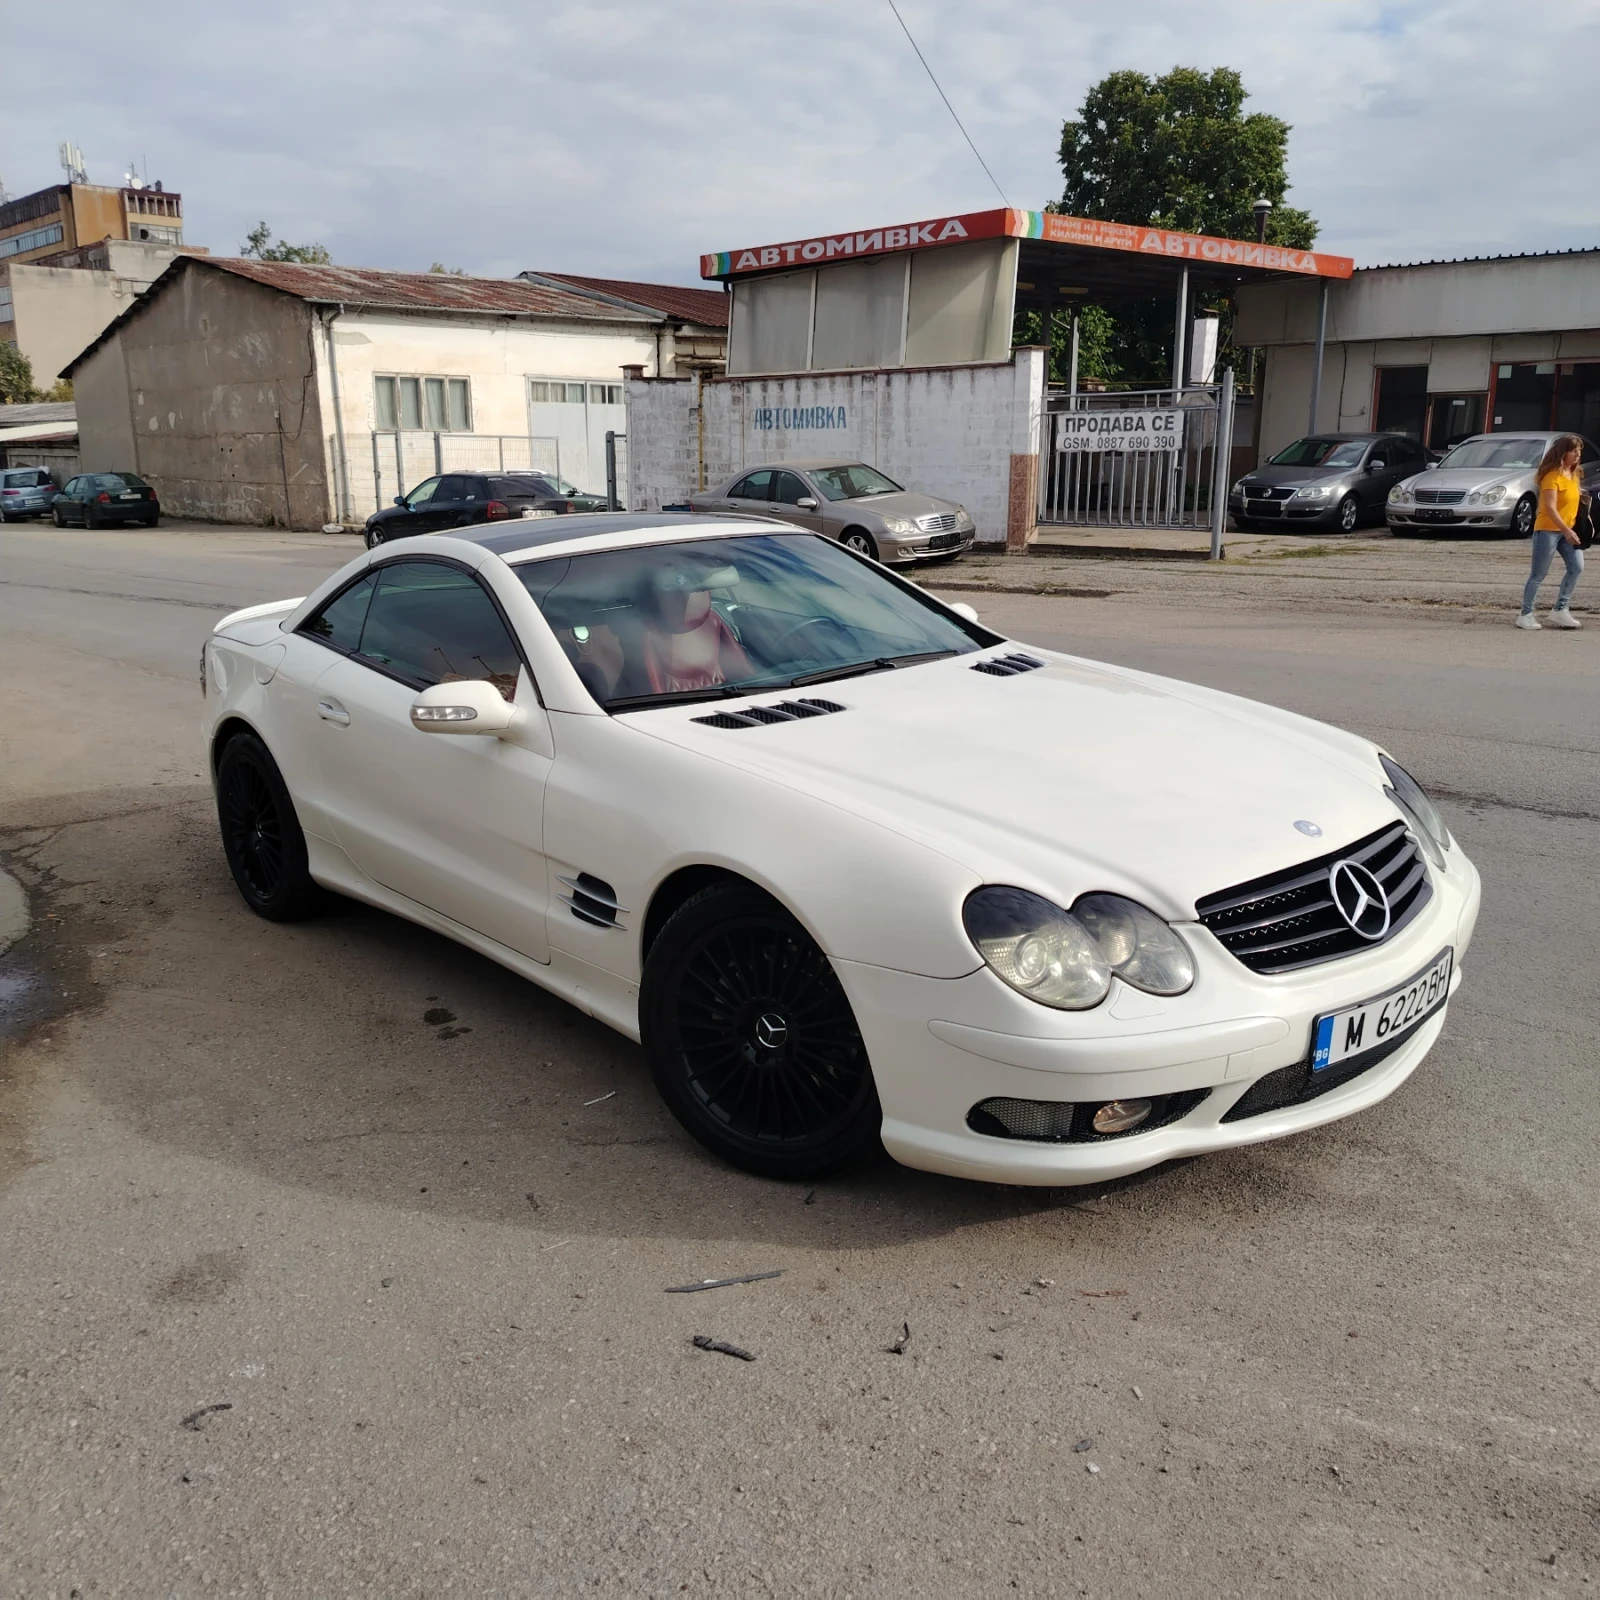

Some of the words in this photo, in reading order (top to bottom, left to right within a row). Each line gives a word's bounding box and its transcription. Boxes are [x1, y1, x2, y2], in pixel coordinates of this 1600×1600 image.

[1050, 218, 1082, 230] ПРАНЕ
[1084, 223, 1098, 232] НА
[735, 220, 969, 270] АВТОМИВКА
[1050, 230, 1093, 241] КИЛИМИ
[1095, 235, 1103, 243] И
[1140, 232, 1318, 272] АВТОМИВКА
[753, 406, 847, 430] АВТОМИВКА
[1065, 416, 1146, 435] ПРОДАВА
[1151, 415, 1175, 431] СЕ
[1063, 437, 1094, 449] GSM:
[1097, 436, 1125, 449] 0887
[1128, 436, 1150, 448] 690
[1153, 436, 1175, 448] 390
[1344, 1012, 1366, 1052] M
[1315, 1048, 1329, 1062] BG
